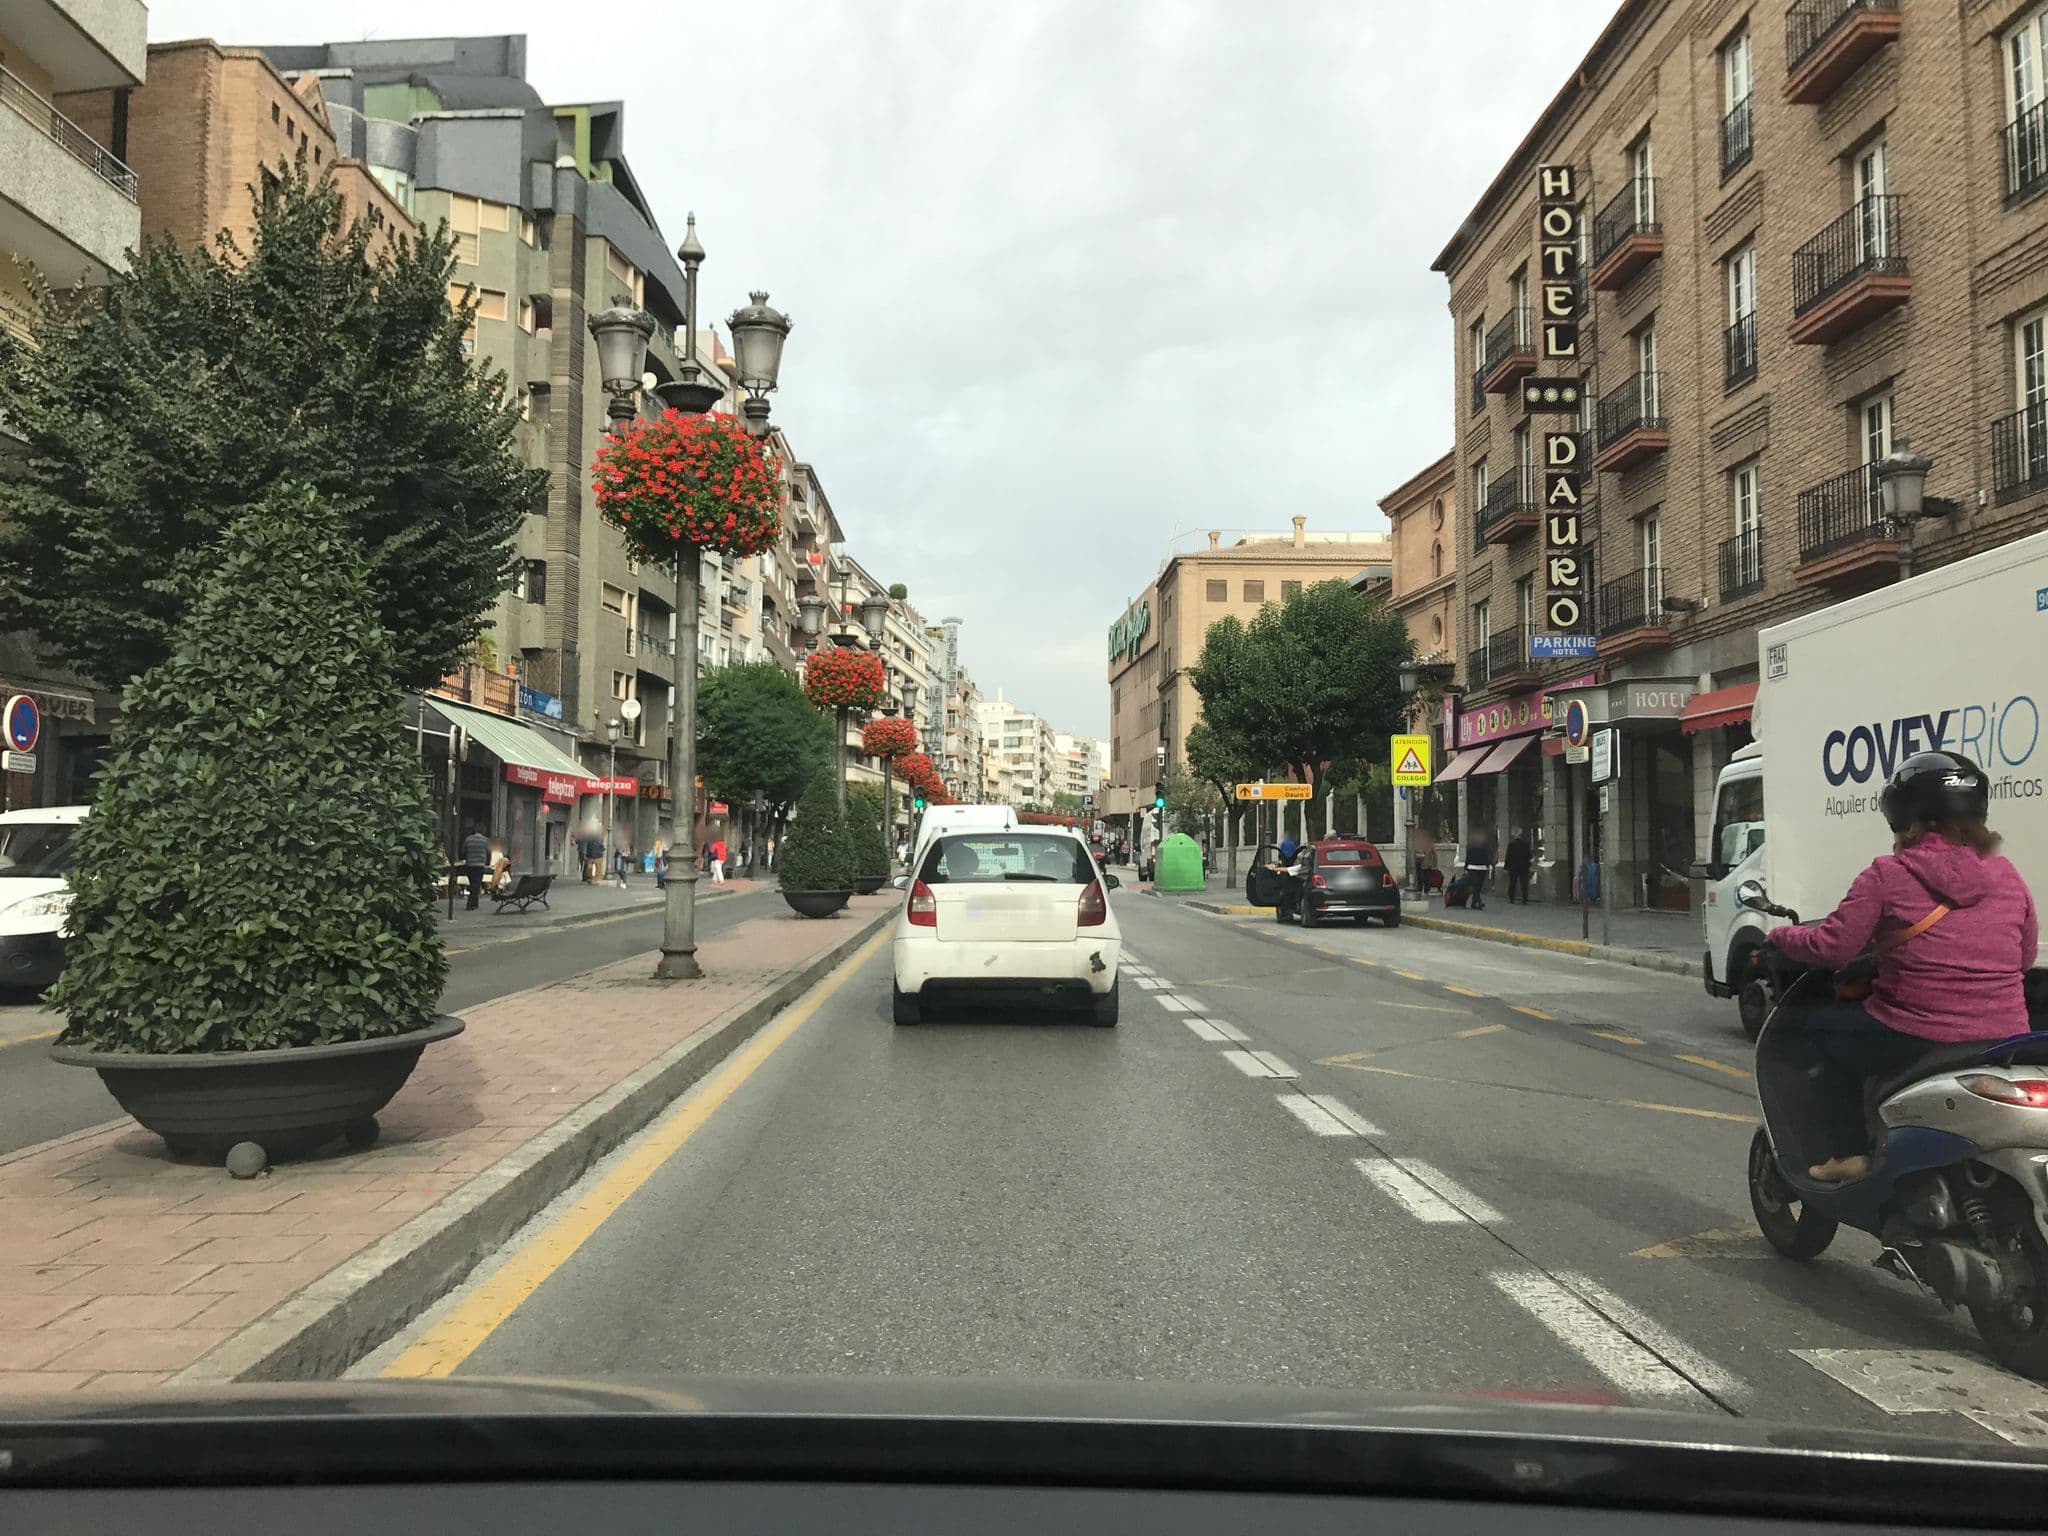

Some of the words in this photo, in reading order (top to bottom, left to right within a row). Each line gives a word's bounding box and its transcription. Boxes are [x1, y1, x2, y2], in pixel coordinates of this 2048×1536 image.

[1542, 168, 1575, 356] HOTEL
[1547, 434, 1580, 628] DAURO
[1534, 636, 1597, 648] PARKING
[1552, 648, 1579, 656] HOTEL
[1636, 692, 1687, 708] HOTEL
[549, 776, 575, 800] telepizza
[586, 779, 632, 792] telepzza
[1825, 794, 1866, 820] Alquiler
